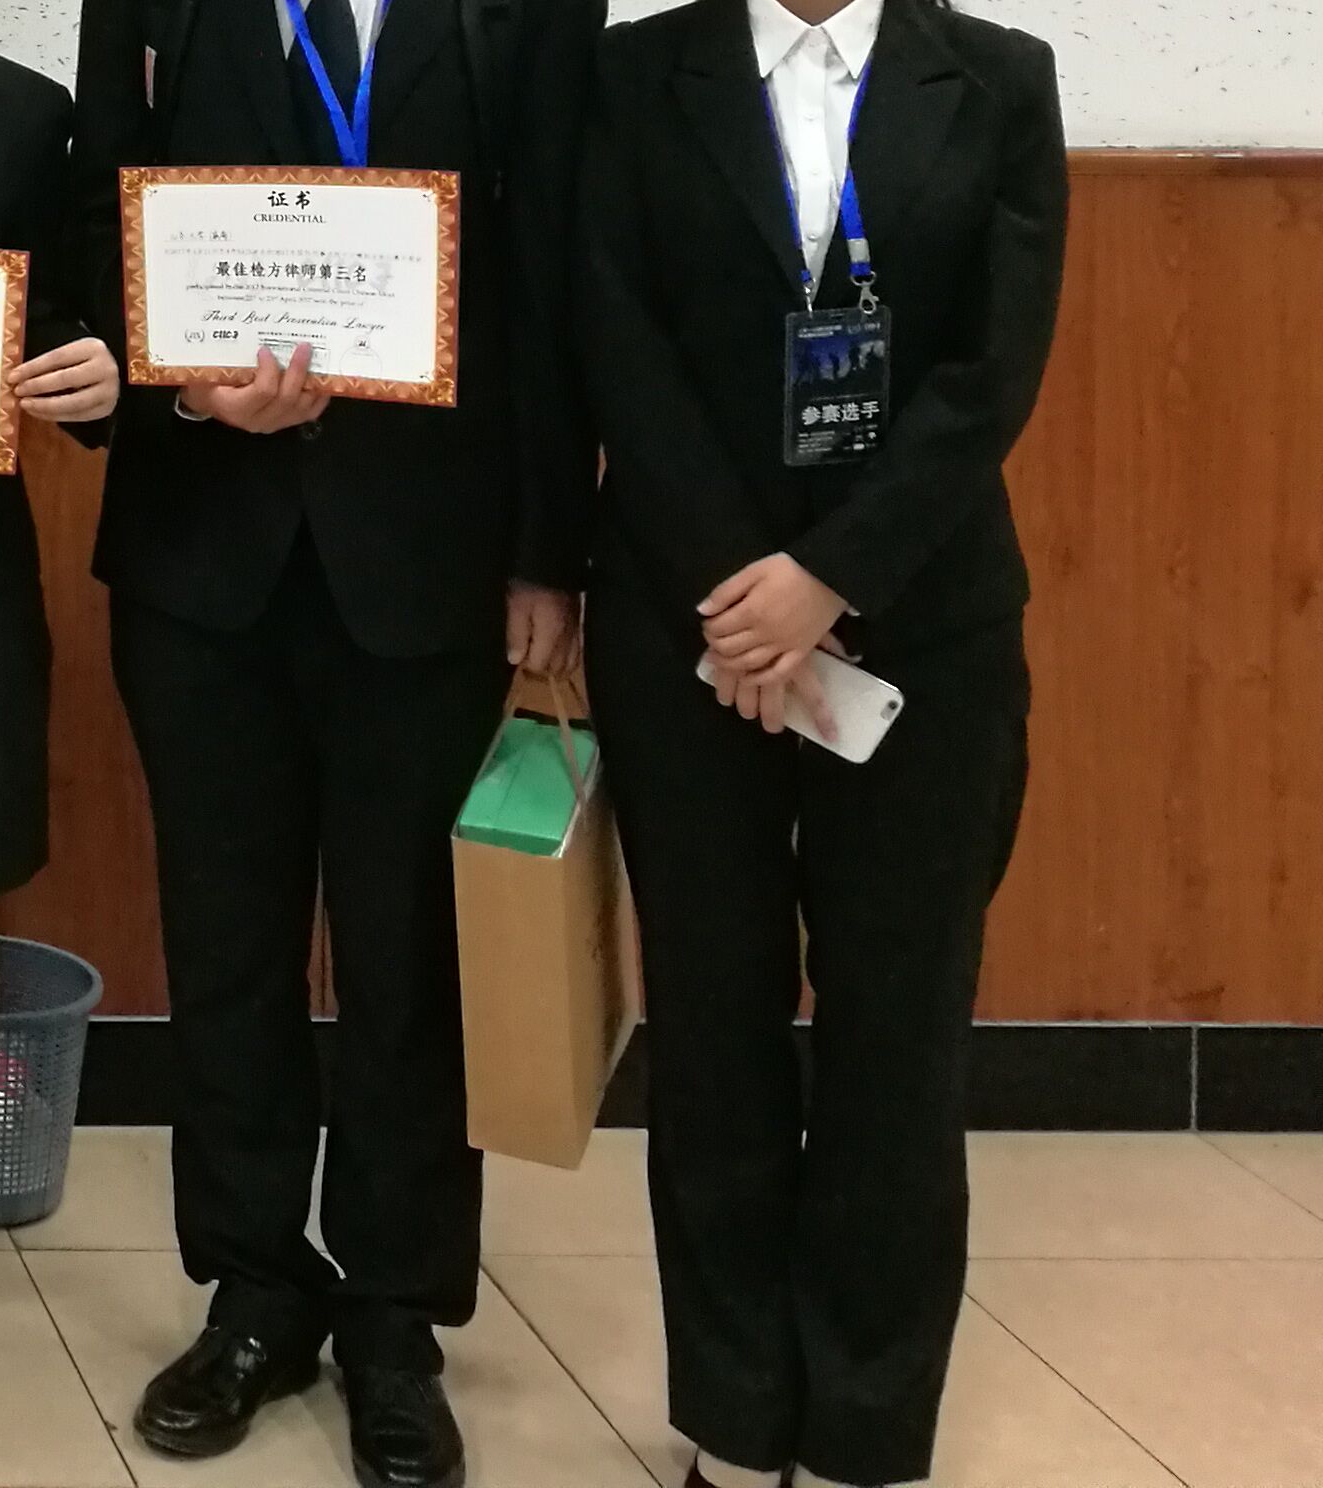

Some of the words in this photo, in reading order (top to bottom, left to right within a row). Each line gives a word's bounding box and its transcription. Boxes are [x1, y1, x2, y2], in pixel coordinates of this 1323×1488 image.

[267, 190, 311, 210] 证书
[253, 213, 327, 224] CREDENTIAL
[216, 261, 367, 282] 最佳检方律师第三名
[801, 401, 880, 426] 参赛选手
